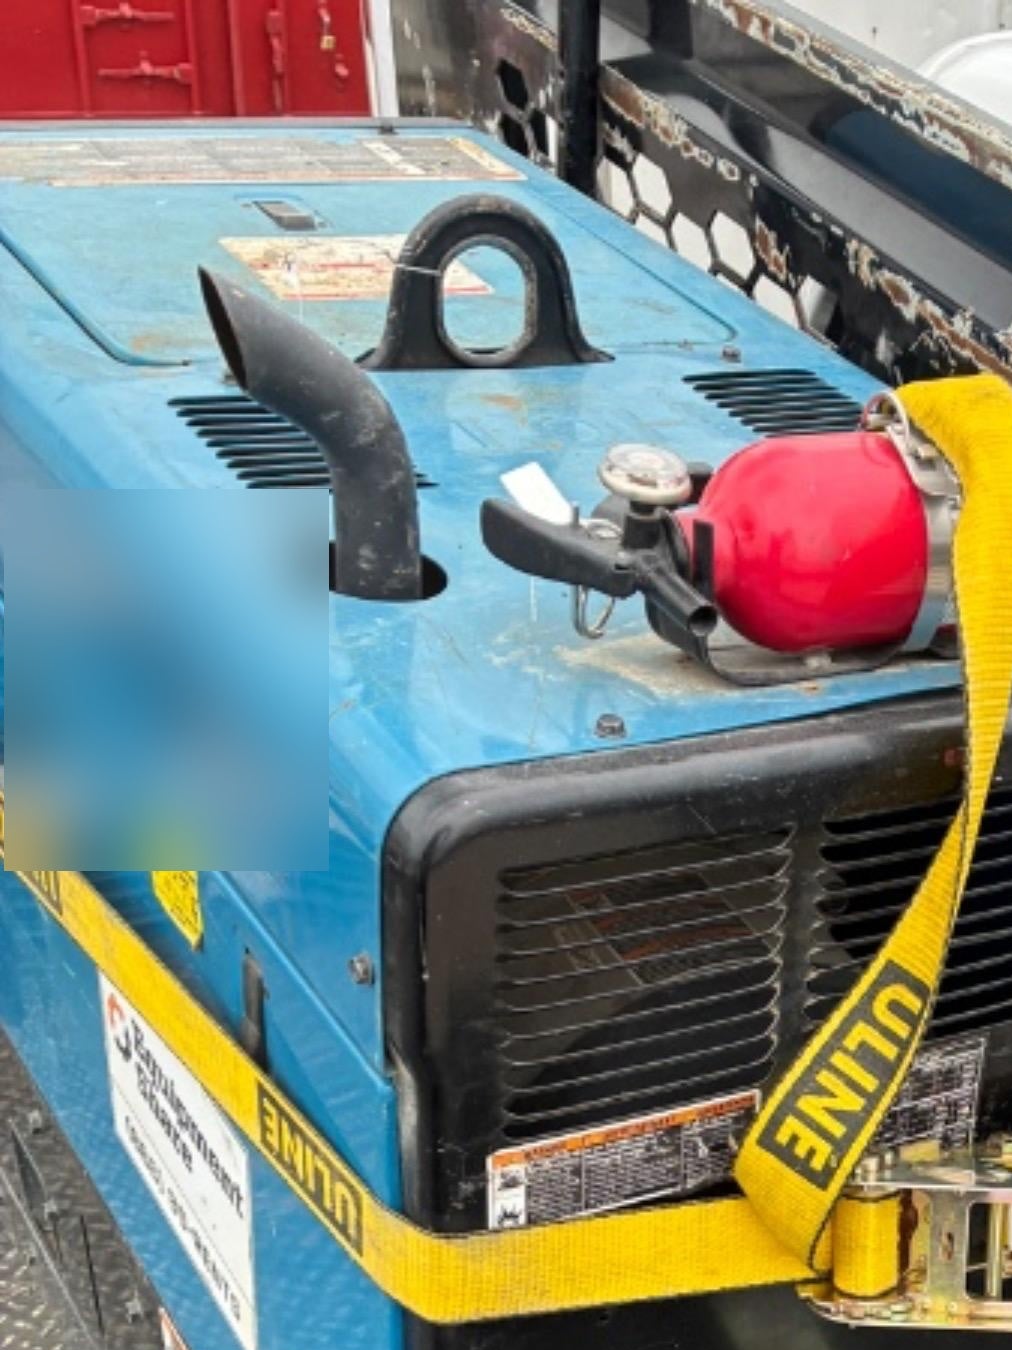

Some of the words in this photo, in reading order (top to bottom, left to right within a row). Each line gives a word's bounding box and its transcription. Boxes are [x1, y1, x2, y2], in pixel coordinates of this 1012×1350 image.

[132, 1018, 244, 1220] Equipment
[135, 1061, 194, 1174] Share
[774, 983, 923, 1172] ULINE
[263, 1097, 359, 1242] ULINE
